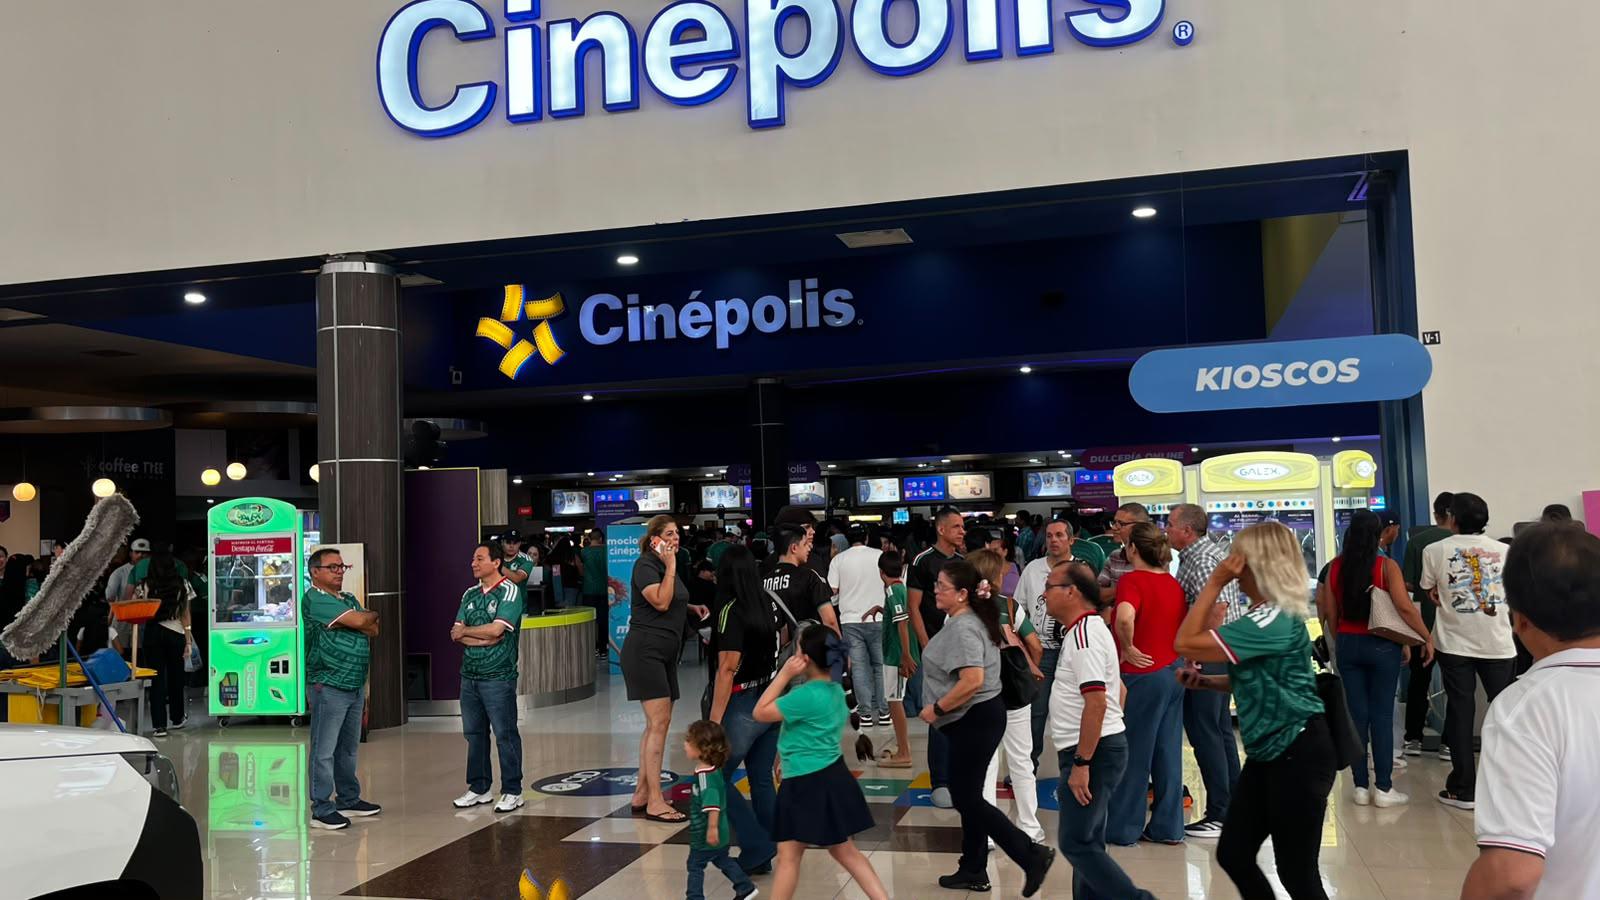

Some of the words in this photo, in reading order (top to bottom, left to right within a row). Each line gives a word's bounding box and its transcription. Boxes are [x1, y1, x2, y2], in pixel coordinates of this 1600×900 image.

[578, 277, 856, 349] Cinépolis
[1424, 332, 1439, 343] V-1
[1195, 357, 1361, 392] KIOSCOS
[98, 457, 139, 473] coffee
